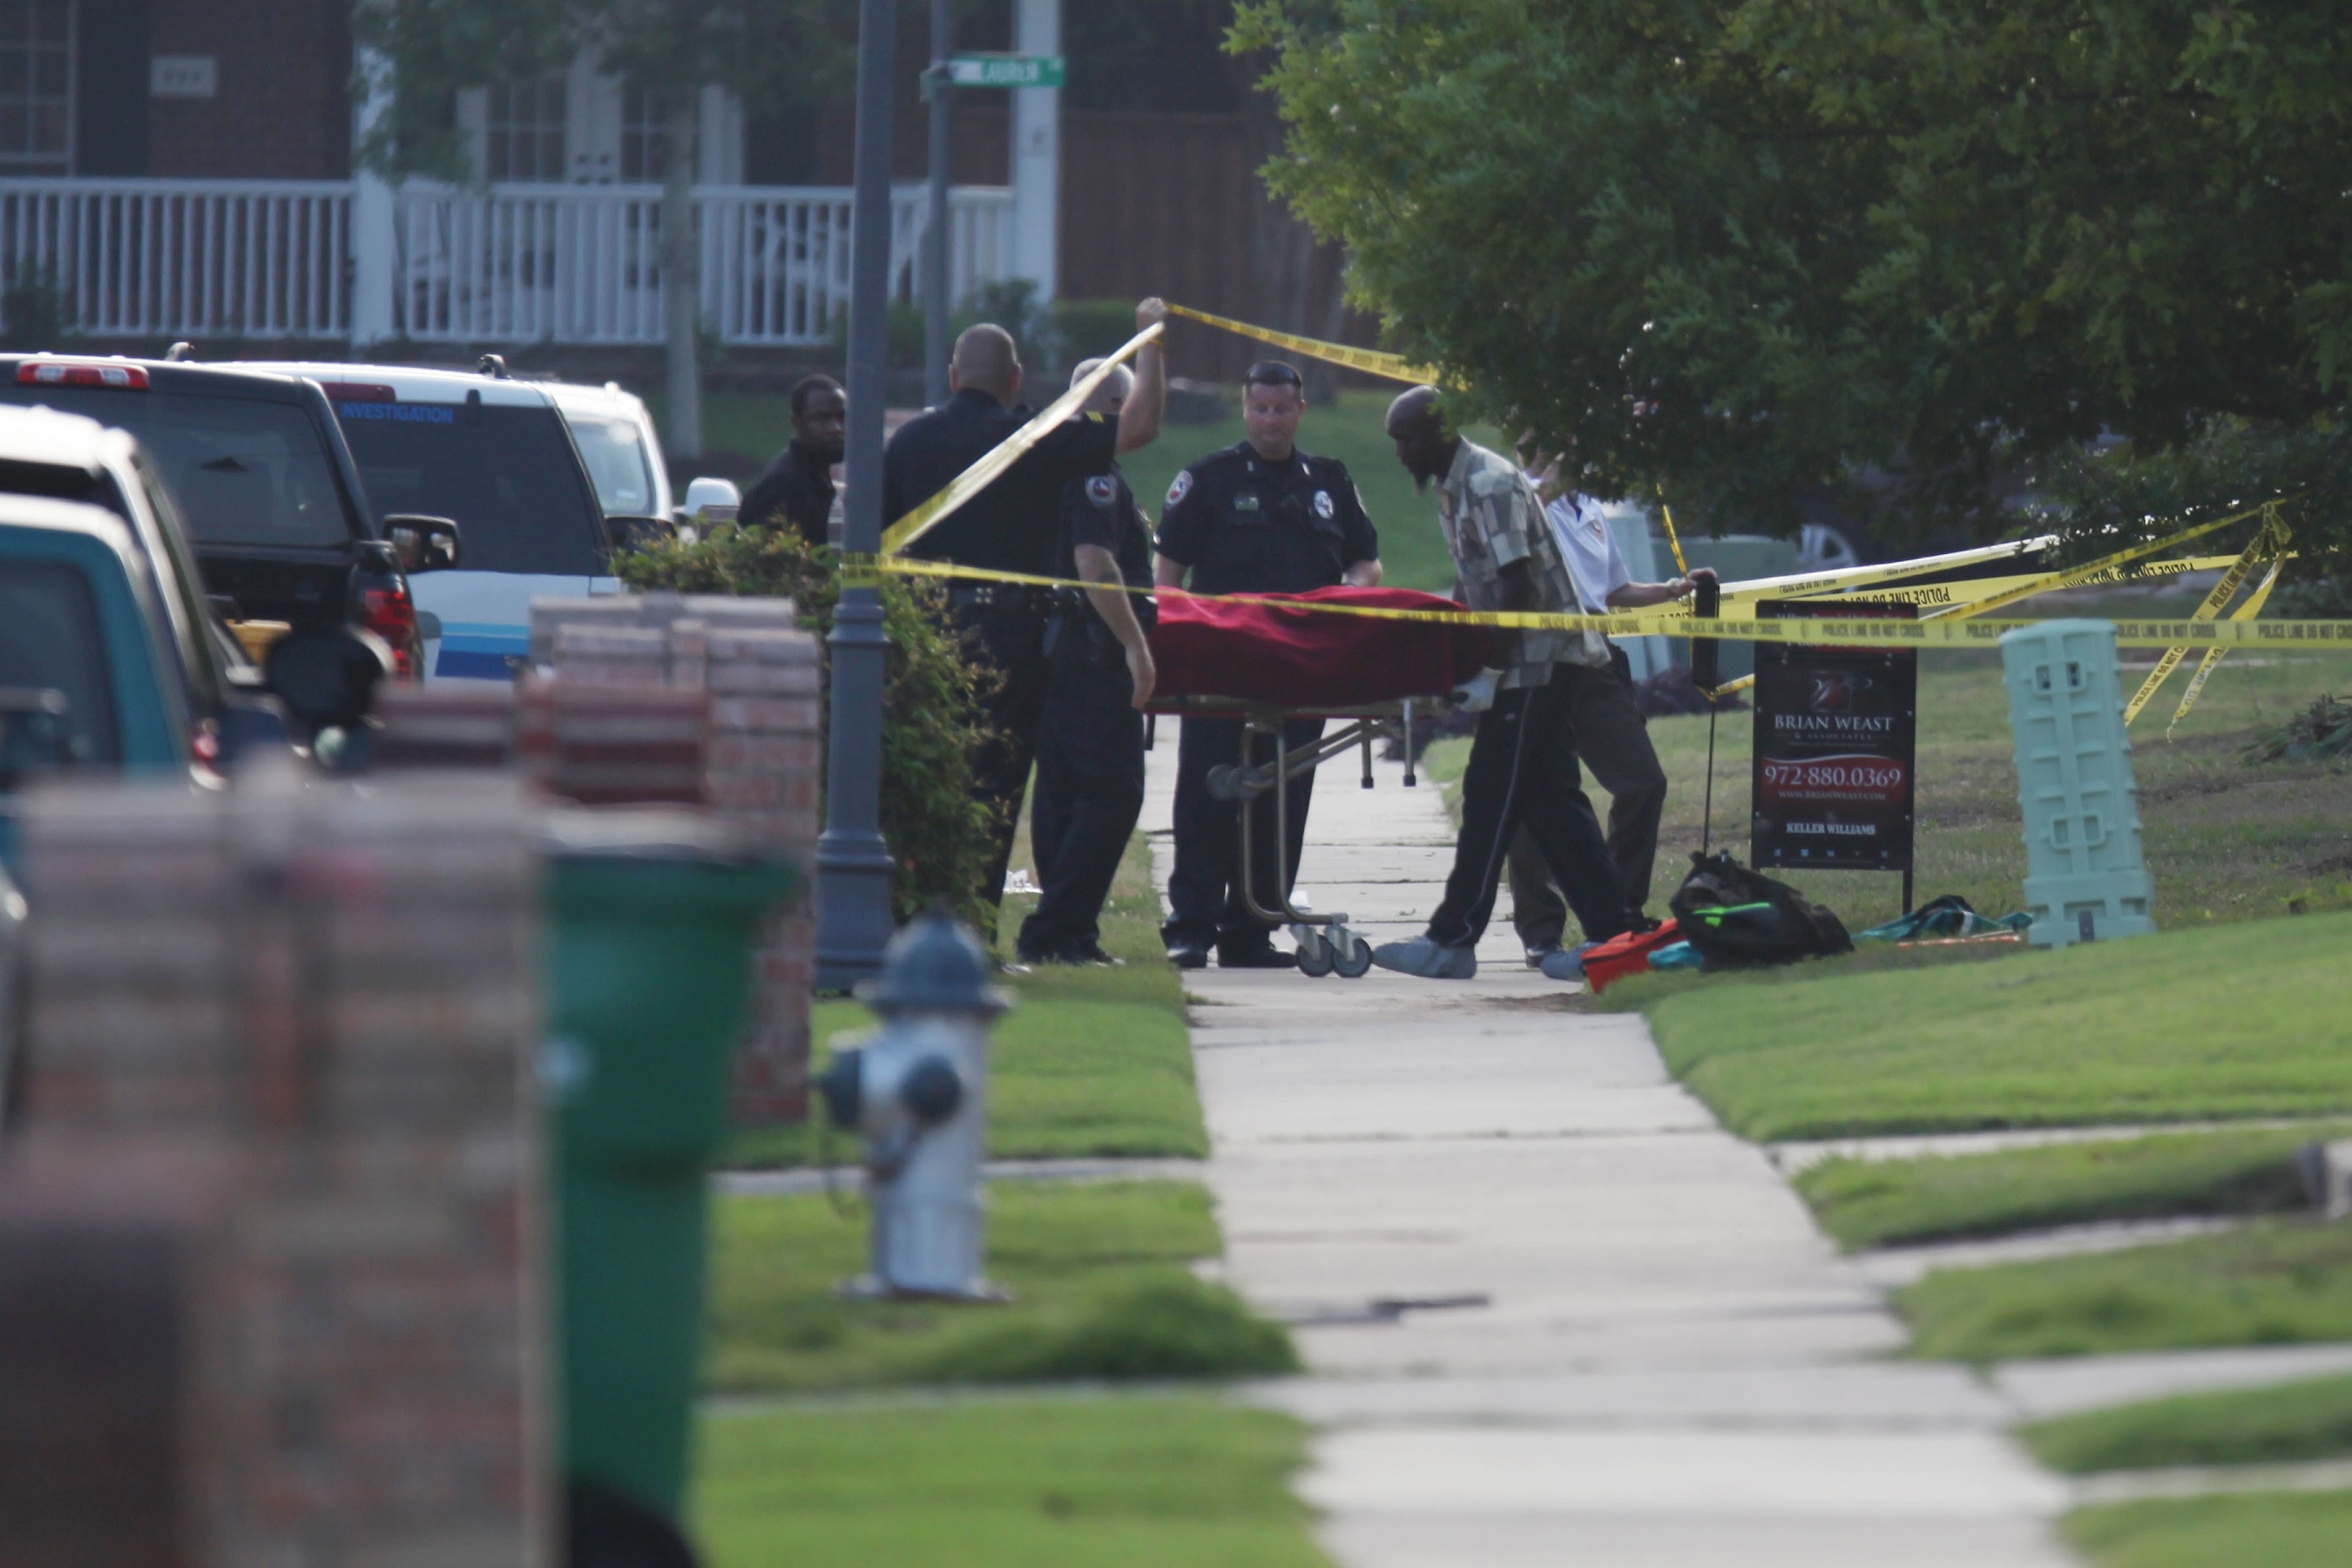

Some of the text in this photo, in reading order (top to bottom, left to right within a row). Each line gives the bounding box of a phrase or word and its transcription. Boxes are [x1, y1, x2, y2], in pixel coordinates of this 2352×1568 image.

[341, 403, 453, 422] INVESTIGATION
[1914, 586, 1950, 605] POLICE
[2209, 585, 2232, 608] POLICE
[2225, 571, 2242, 588] LINE
[2117, 624, 2139, 639] OLICE
[1774, 714, 1893, 731] BRIAN WEAST
[1808, 733, 1872, 741] ASSOCIATES
[1787, 823, 1876, 835] KELLER WILLIAMS
